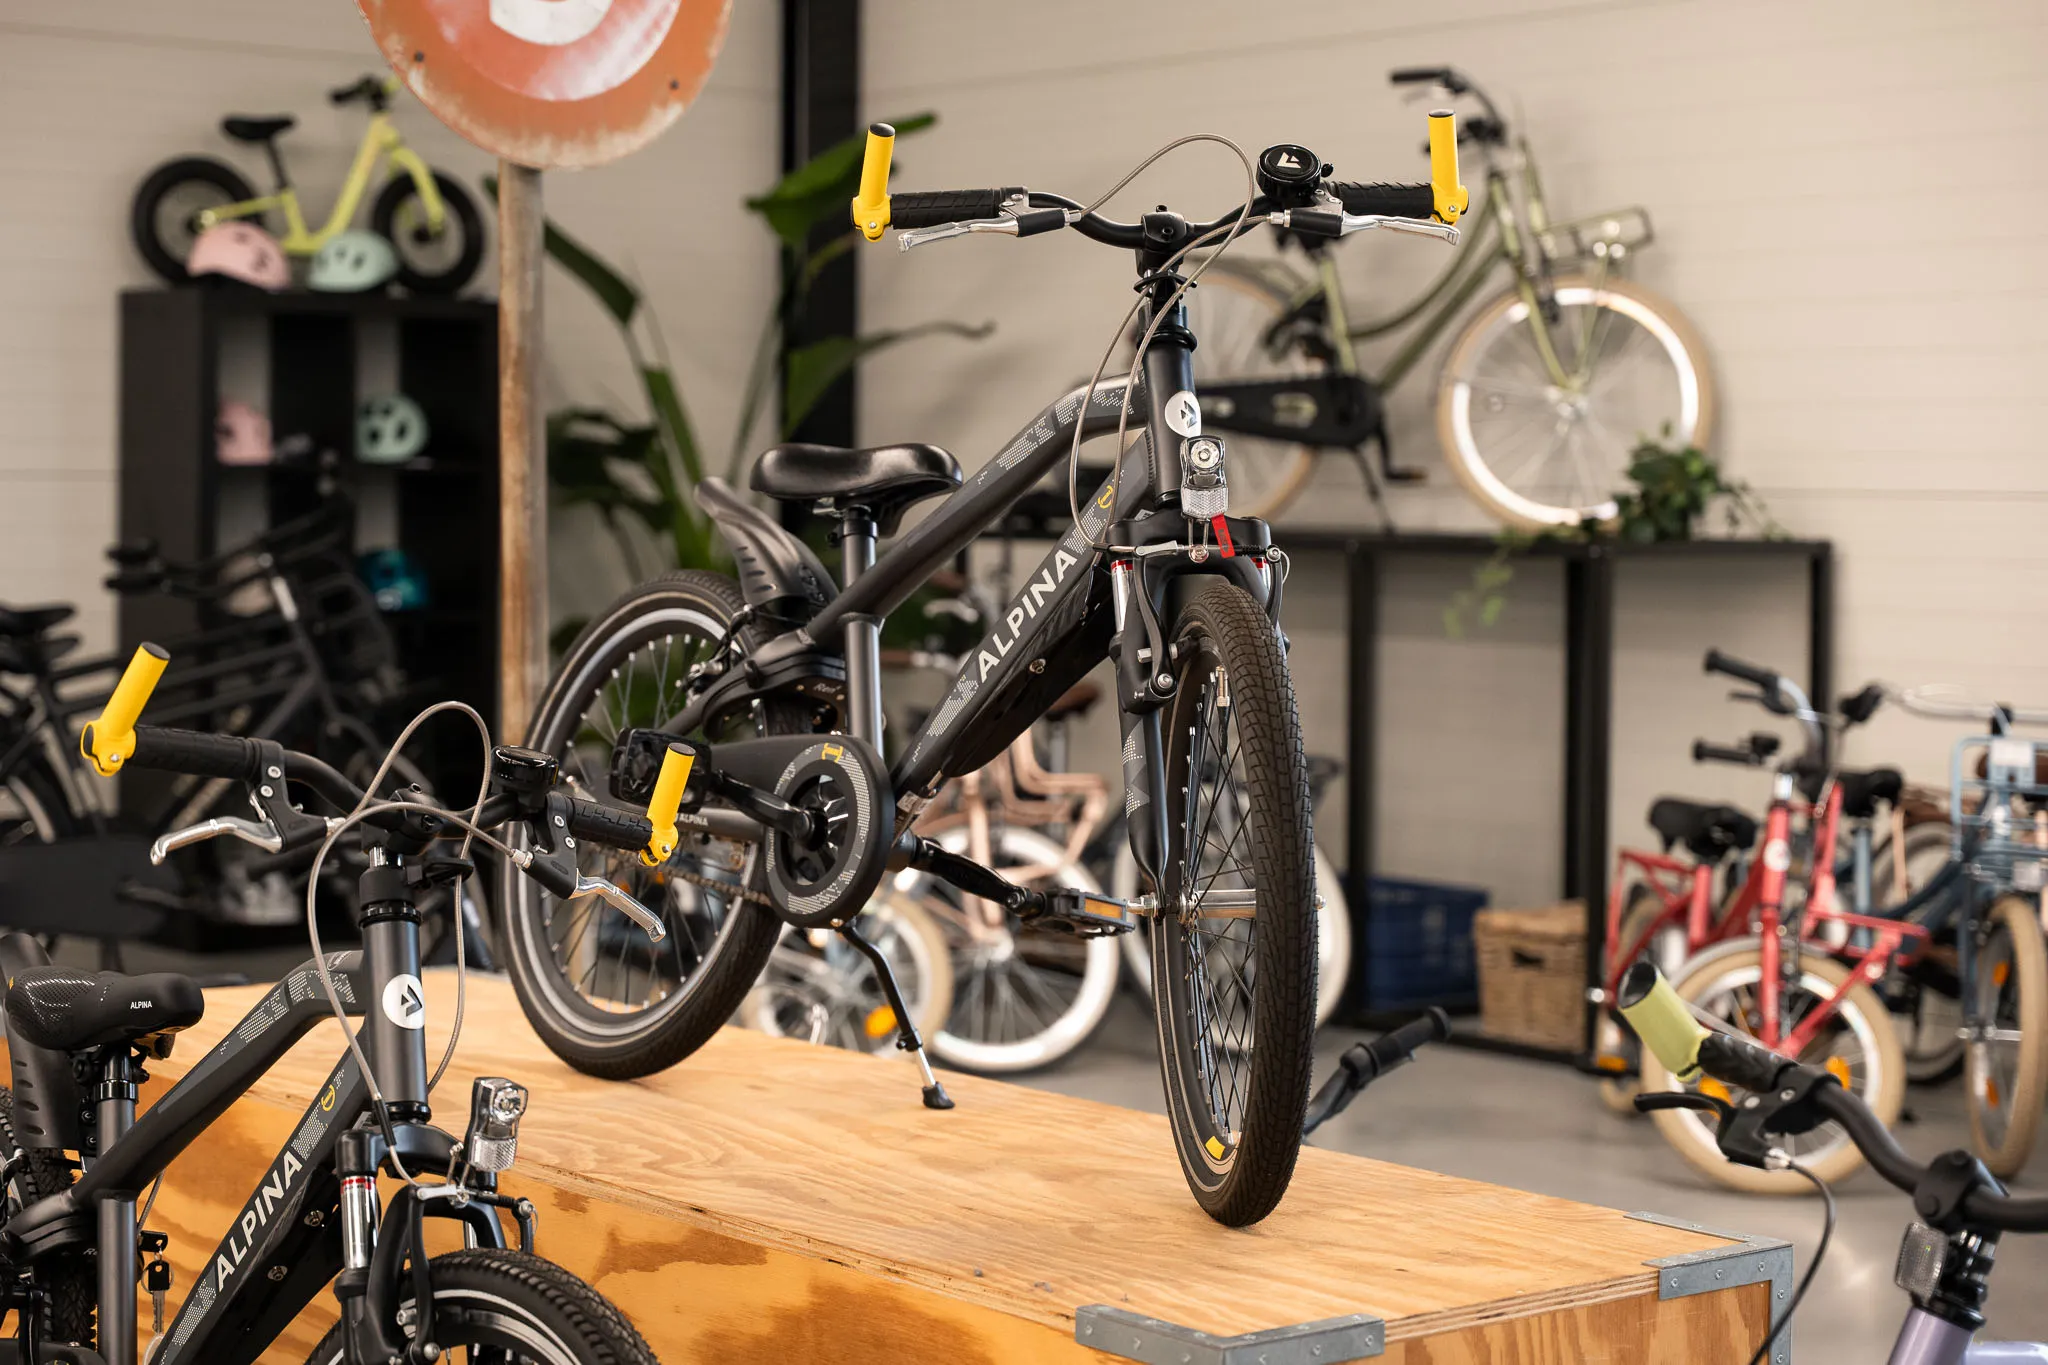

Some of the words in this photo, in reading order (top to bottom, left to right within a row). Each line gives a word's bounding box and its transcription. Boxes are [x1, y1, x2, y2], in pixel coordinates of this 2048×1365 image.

[978, 549, 1077, 683] ALPINA
[679, 813, 708, 826] ALPINA
[130, 1001, 153, 1010] ALPINA
[216, 1150, 303, 1292] ALPINA
